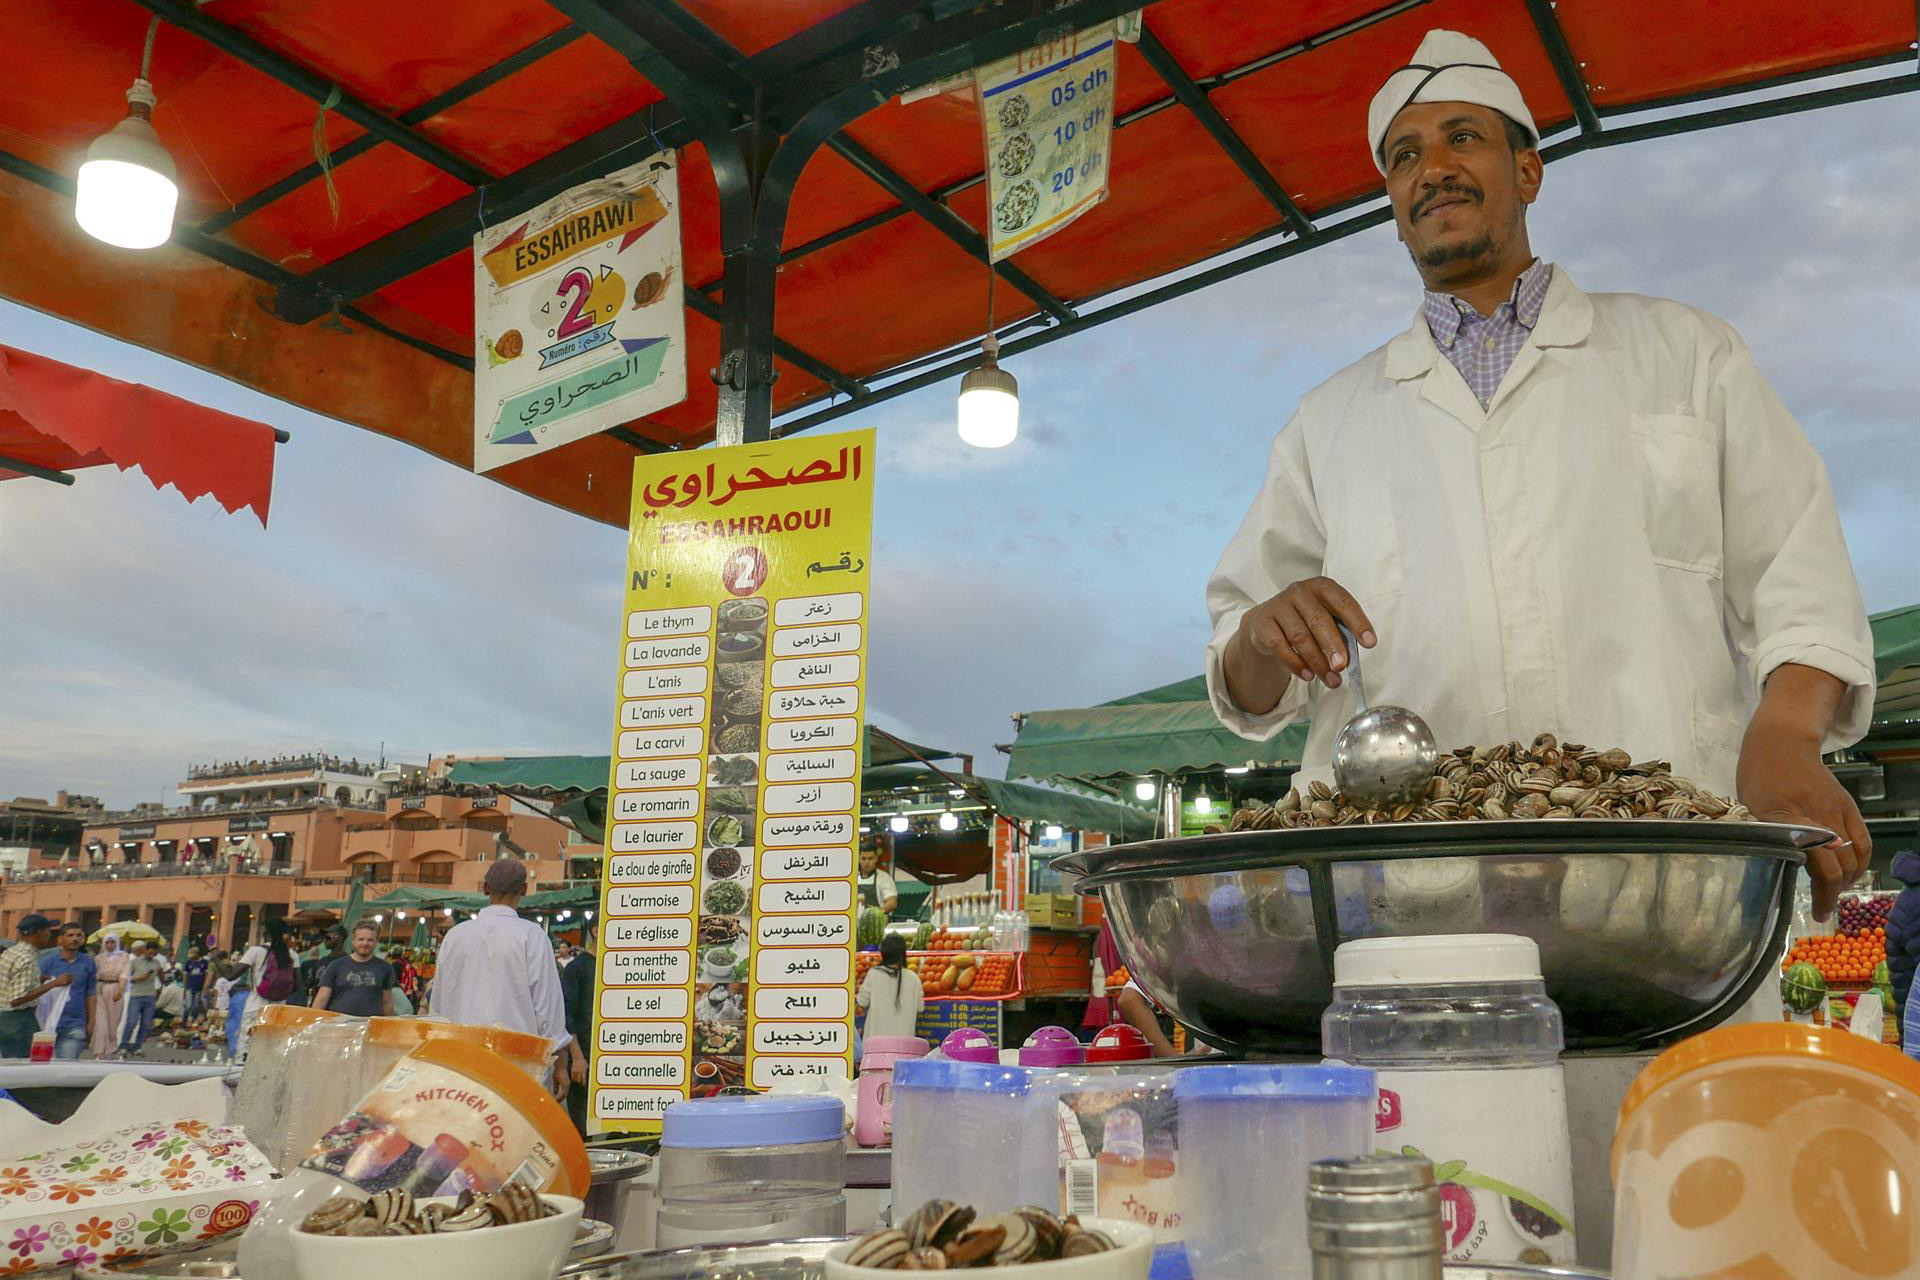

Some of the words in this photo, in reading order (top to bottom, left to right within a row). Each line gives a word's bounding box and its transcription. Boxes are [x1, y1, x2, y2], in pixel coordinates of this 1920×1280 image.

[1051, 80, 1076, 107] 05
[1082, 68, 1108, 93] dh
[1053, 124, 1076, 145] 10
[1083, 107, 1105, 132] dh
[1052, 167, 1074, 193] 20
[1080, 152, 1102, 177] dh
[515, 199, 636, 272] ESSAHRAWI
[556, 267, 597, 341] 2
[519, 356, 638, 427] الصحراوي
[643, 445, 862, 520] الصحراوي
[660, 507, 831, 545] ESSAHRAOUI
[734, 552, 756, 589] 2
[806, 551, 865, 578] رقم
[804, 603, 832, 616] زعتر
[644, 618, 659, 630] Le
[662, 616, 694, 630] thym
[792, 632, 841, 648] الخزامى
[633, 648, 648, 660] La
[652, 644, 702, 659] lavande
[798, 664, 832, 679] النافع
[648, 676, 682, 689] L'anis
[780, 696, 816, 710] حلاوة
[819, 696, 846, 709] حبة
[632, 707, 665, 720] L'anis
[669, 705, 693, 717] vert
[790, 726, 834, 742] الكرويا
[636, 737, 651, 750] La
[655, 736, 685, 749] carvi
[786, 758, 835, 774] السالمية
[631, 768, 647, 781] La
[649, 768, 686, 782] sauge
[622, 799, 637, 813] Le
[640, 798, 690, 812] romarin
[770, 824, 810, 836] موسى
[812, 820, 844, 834] ورقة
[625, 831, 640, 844] Le
[643, 830, 684, 843] laurier
[612, 862, 623, 876] Le
[626, 861, 645, 875] clou
[648, 861, 660, 875] de
[662, 859, 692, 877] girofle
[783, 856, 829, 871] القرنفل
[620, 894, 679, 908] L'armoise
[784, 888, 825, 905] الشيح
[617, 926, 632, 940] Le
[635, 926, 679, 941] réglisse
[763, 924, 815, 939] السوس
[817, 923, 844, 938] عرق
[615, 954, 630, 966] La
[633, 953, 678, 966] menthe
[785, 958, 821, 974] فليو
[625, 969, 666, 984] pouliot
[627, 997, 642, 1010] Le
[645, 996, 661, 1010] sel
[784, 996, 817, 1010] الملح
[602, 1030, 616, 1043] Le
[619, 1029, 683, 1045] gingembre
[763, 1030, 838, 1045] الزنجبيل
[604, 1063, 620, 1077] La
[624, 1063, 677, 1077] cannelle
[771, 1064, 828, 1077] القفة
[602, 1097, 614, 1110] Le
[617, 1098, 654, 1112] piment
[415, 1088, 488, 1113] KITCHEN
[484, 1114, 505, 1152] BOX
[219, 1208, 243, 1222] 100
